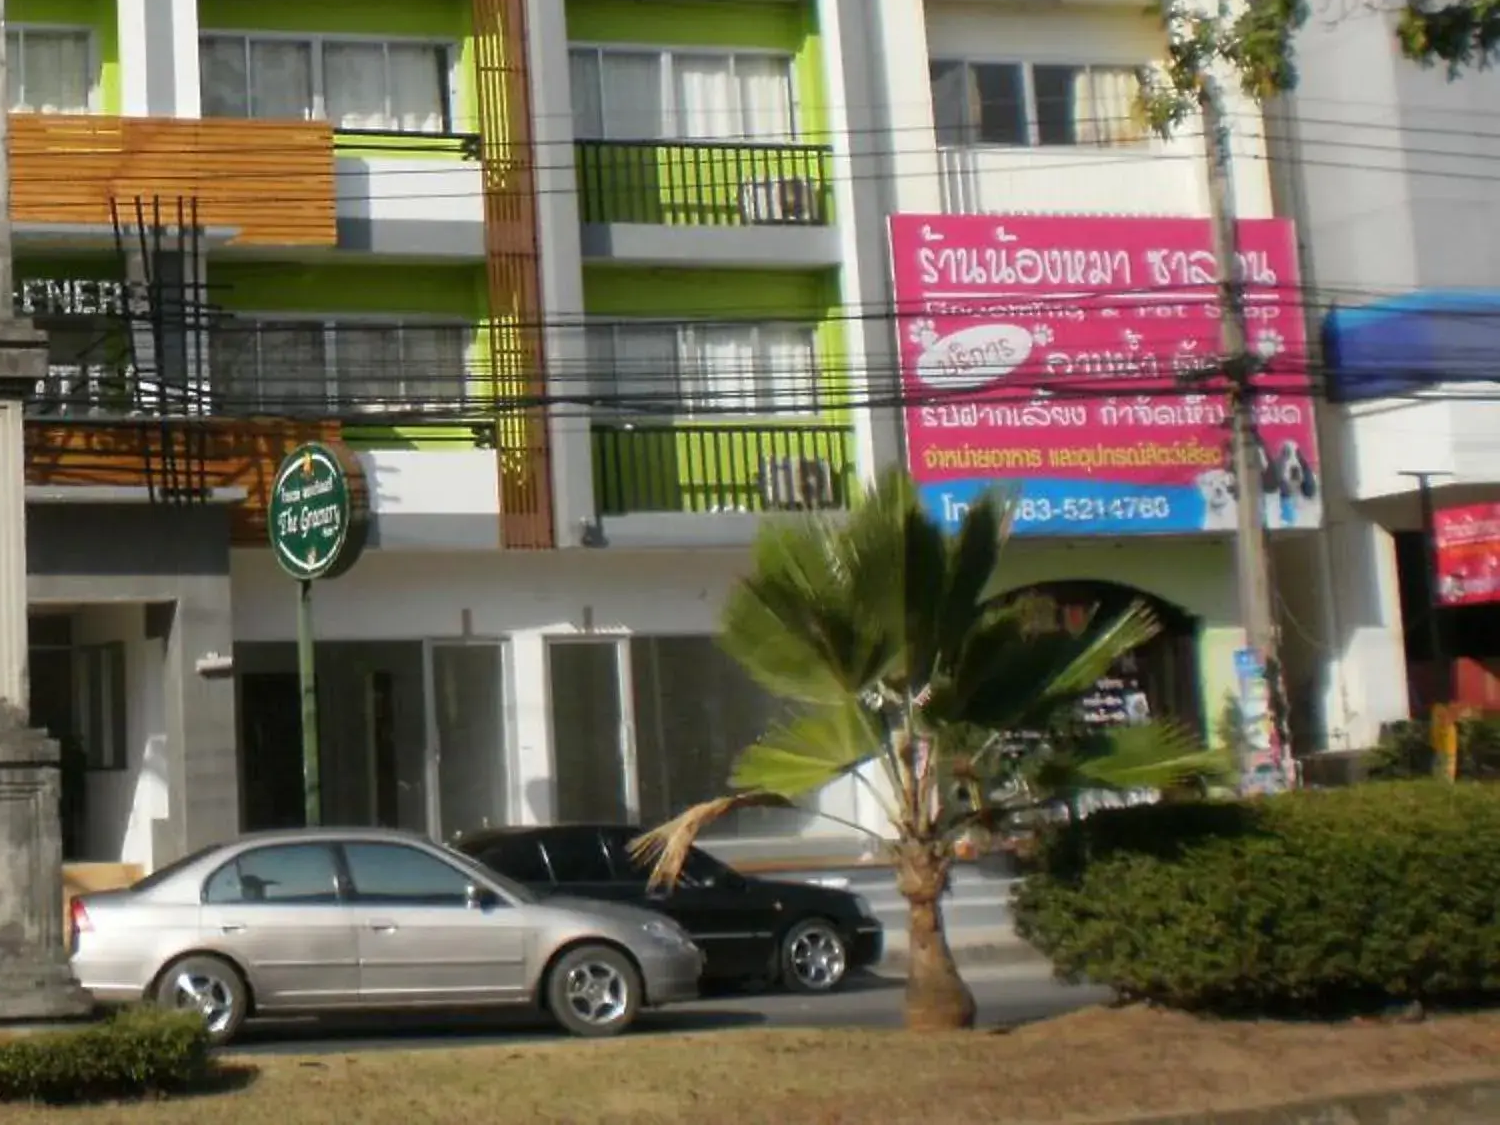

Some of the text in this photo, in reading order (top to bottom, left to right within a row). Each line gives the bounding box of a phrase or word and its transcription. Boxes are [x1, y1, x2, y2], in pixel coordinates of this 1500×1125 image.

[919, 224, 1132, 285] ร้านน้องหมา
